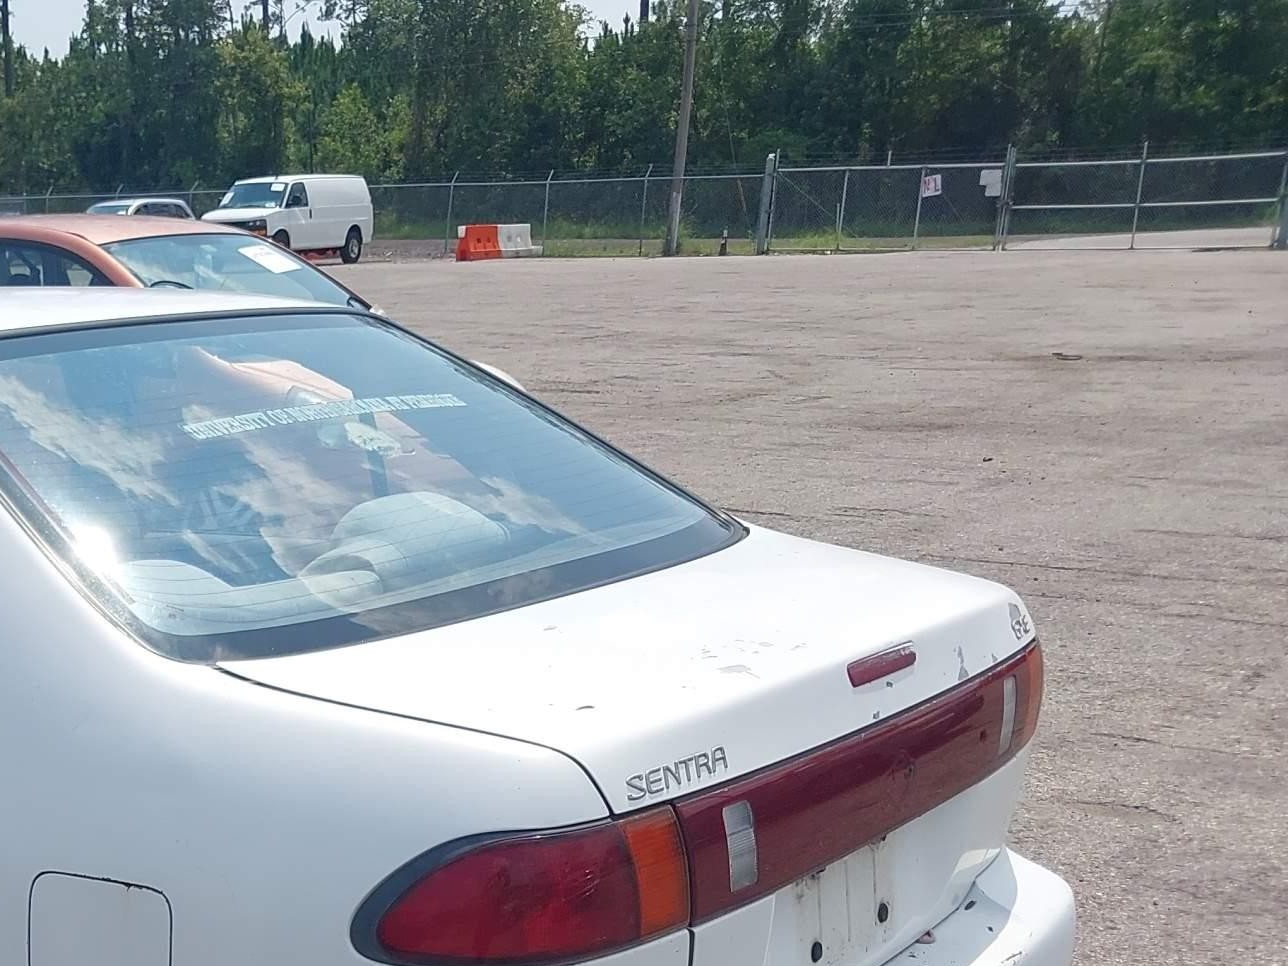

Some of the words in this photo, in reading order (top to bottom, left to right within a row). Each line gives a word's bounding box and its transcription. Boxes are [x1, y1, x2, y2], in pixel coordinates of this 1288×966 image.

[182, 411, 276, 440] UNIVERSITY
[266, 409, 293, 425] OF
[625, 744, 729, 801] SENTRA
